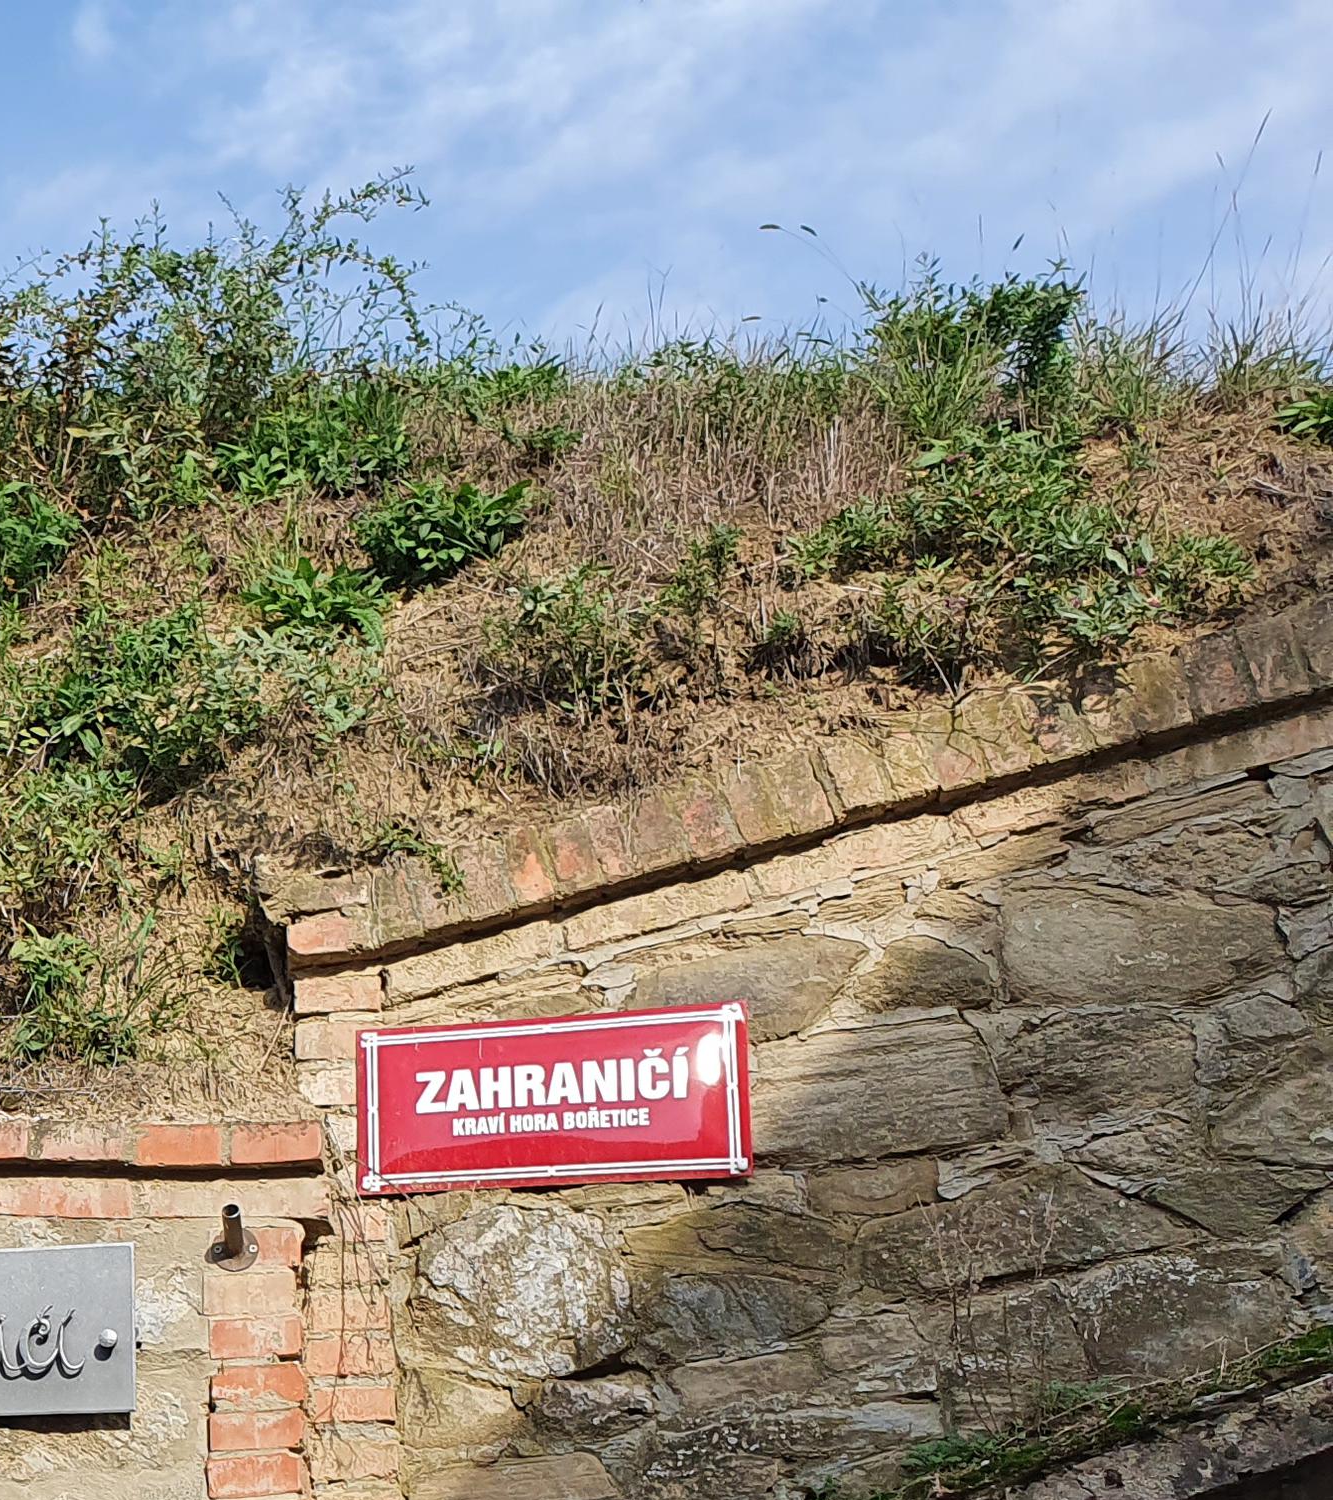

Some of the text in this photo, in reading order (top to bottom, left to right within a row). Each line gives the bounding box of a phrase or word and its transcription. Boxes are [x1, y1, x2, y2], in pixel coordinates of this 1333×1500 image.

[415, 1047, 689, 1115] ZAHRANIČÍ
[452, 1106, 650, 1136] KRAVÍ HORA BOŘETICE
